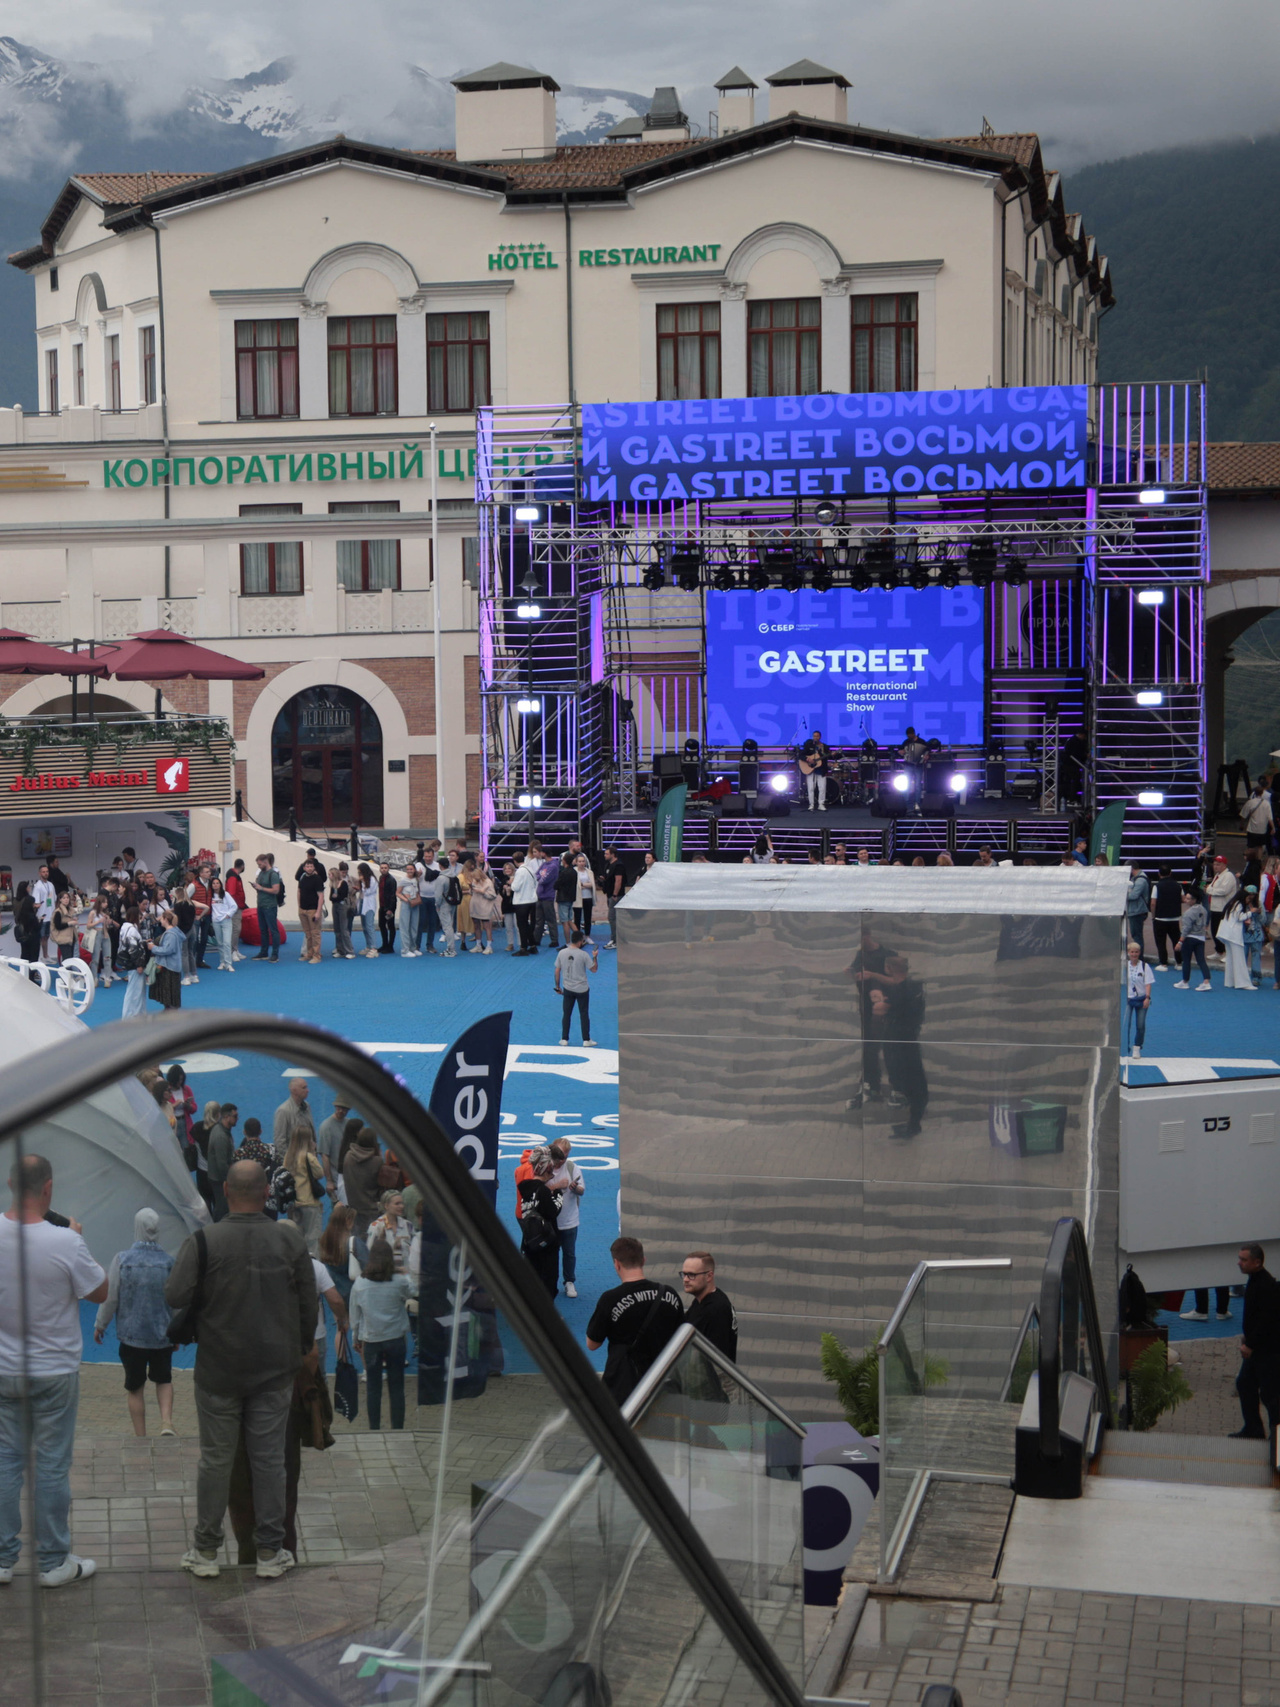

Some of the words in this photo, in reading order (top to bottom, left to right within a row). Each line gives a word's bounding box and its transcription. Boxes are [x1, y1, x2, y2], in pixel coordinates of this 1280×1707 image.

[488, 251, 559, 270] HOTEL
[579, 244, 722, 266] RESTAURANT
[620, 429, 842, 466] GASTREET
[855, 412, 1076, 458] ВОСЬМОЙ
[103, 443, 424, 488] КОРПОРАТИВНЫЙ
[629, 467, 851, 500] GASTREET
[864, 451, 1085, 494] ВОСЬМОЙ
[770, 624, 795, 632] СБЕР
[1027, 617, 1070, 628] ПРОКА
[758, 649, 929, 673] GASTREET
[846, 681, 917, 691] International
[846, 692, 908, 701] Restaurant
[846, 703, 875, 712] Show
[9, 773, 81, 791] Julius
[87, 769, 149, 787] Meinl
[663, 814, 672, 863] ОКОМПЛЕКС
[1202, 1116, 1231, 1132] D3
[634, 1289, 658, 1302] WITH
